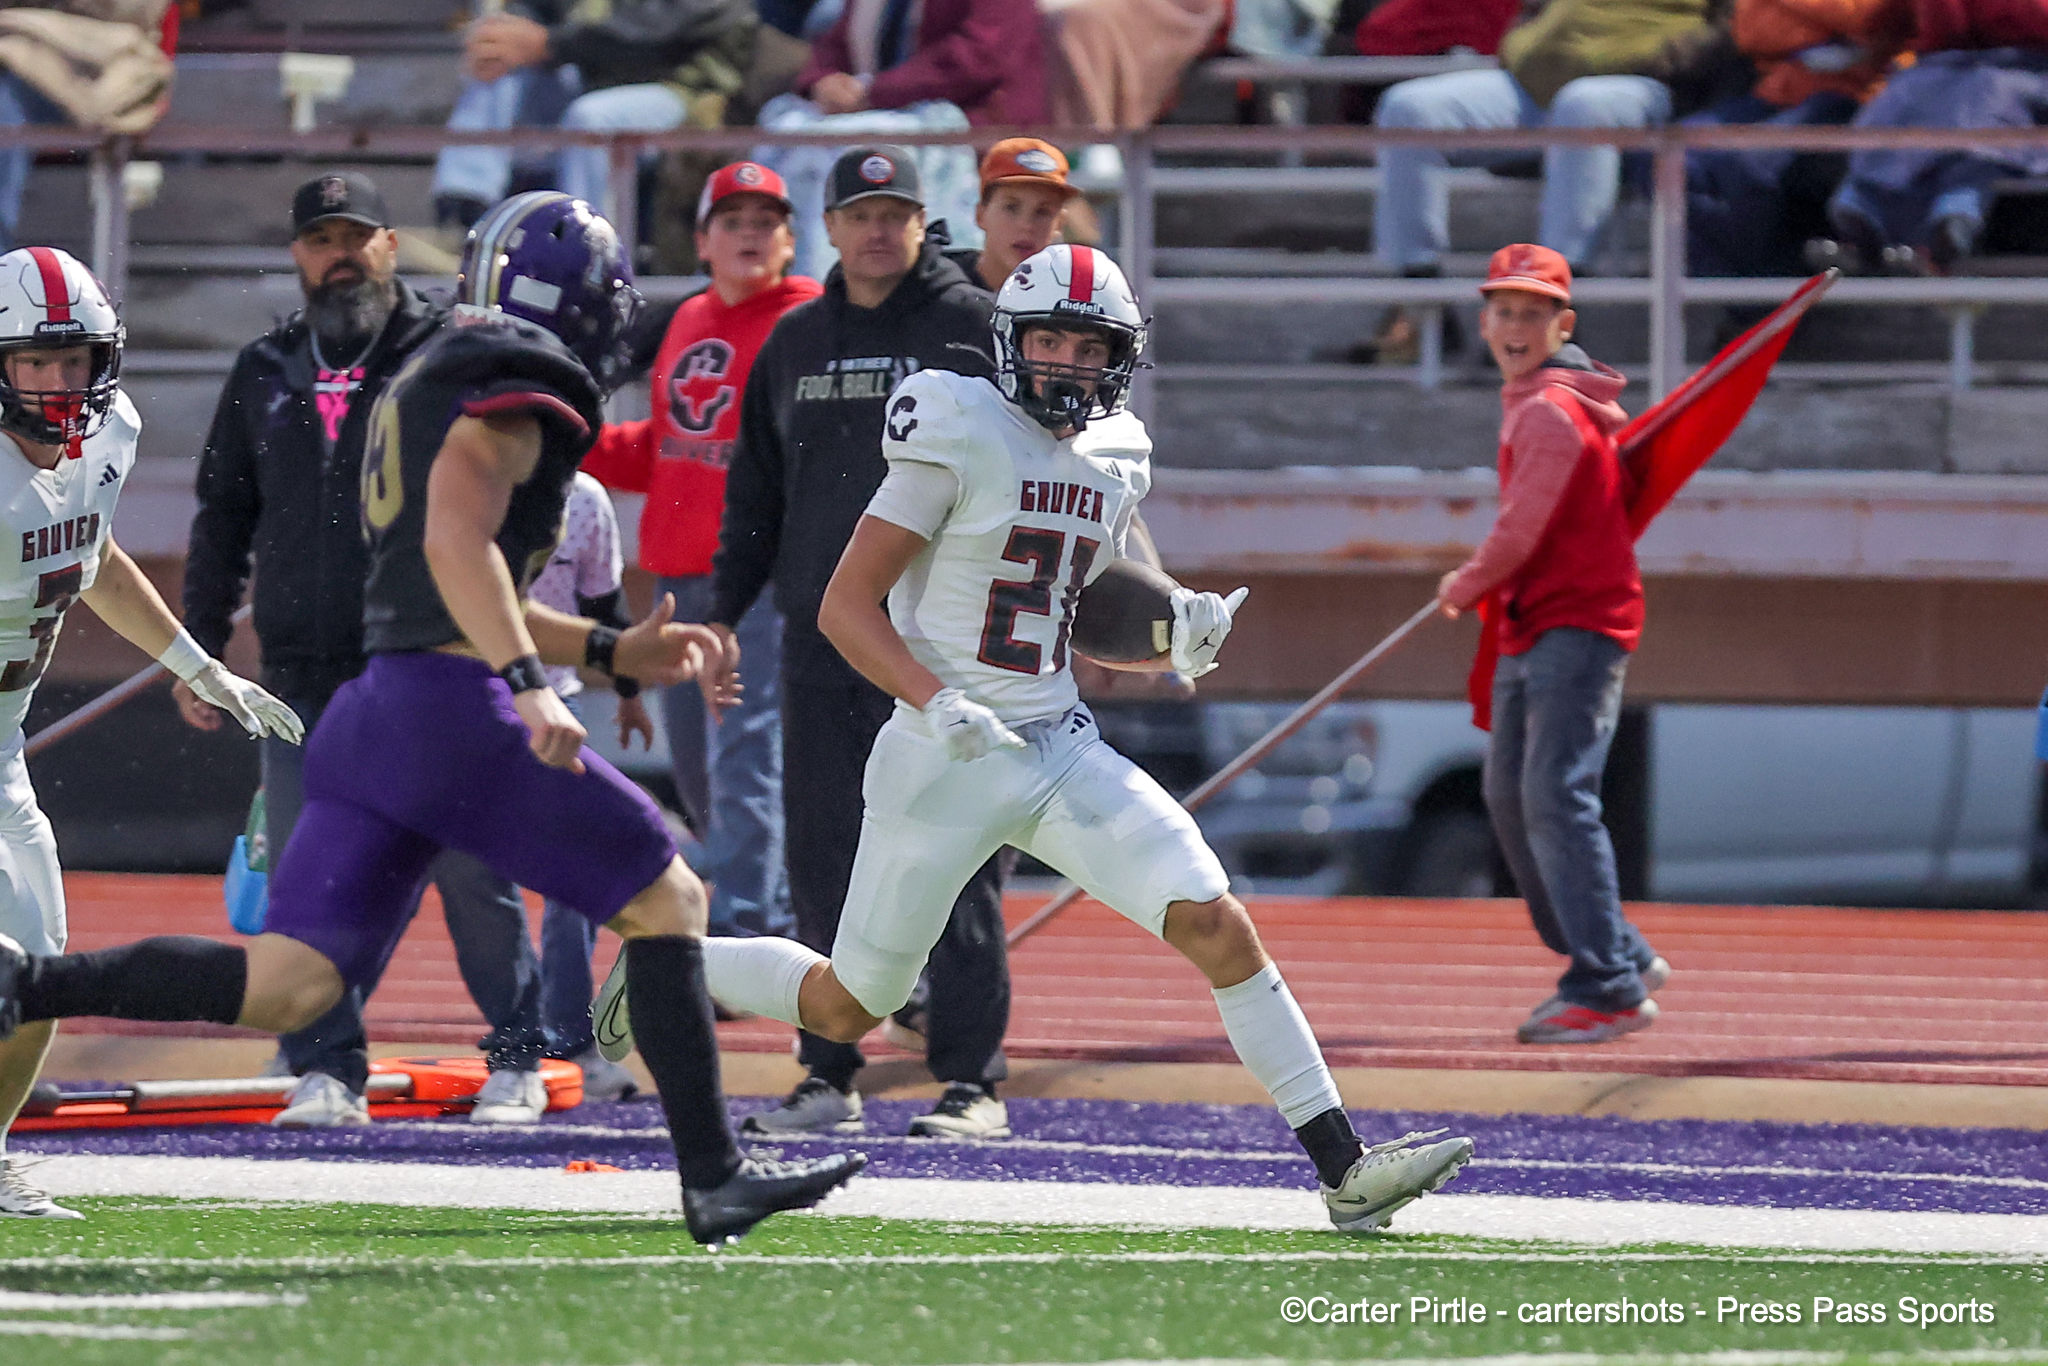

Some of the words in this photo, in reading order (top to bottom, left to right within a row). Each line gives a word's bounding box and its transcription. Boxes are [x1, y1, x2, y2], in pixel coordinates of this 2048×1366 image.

[1060, 300, 1101, 314] Riddell
[826, 356, 893, 373] PNTHER
[796, 372, 887, 400] FOOBALL
[1020, 480, 1104, 523] GRUVER
[22, 512, 100, 563] GRUVER
[977, 525, 1101, 676] 21
